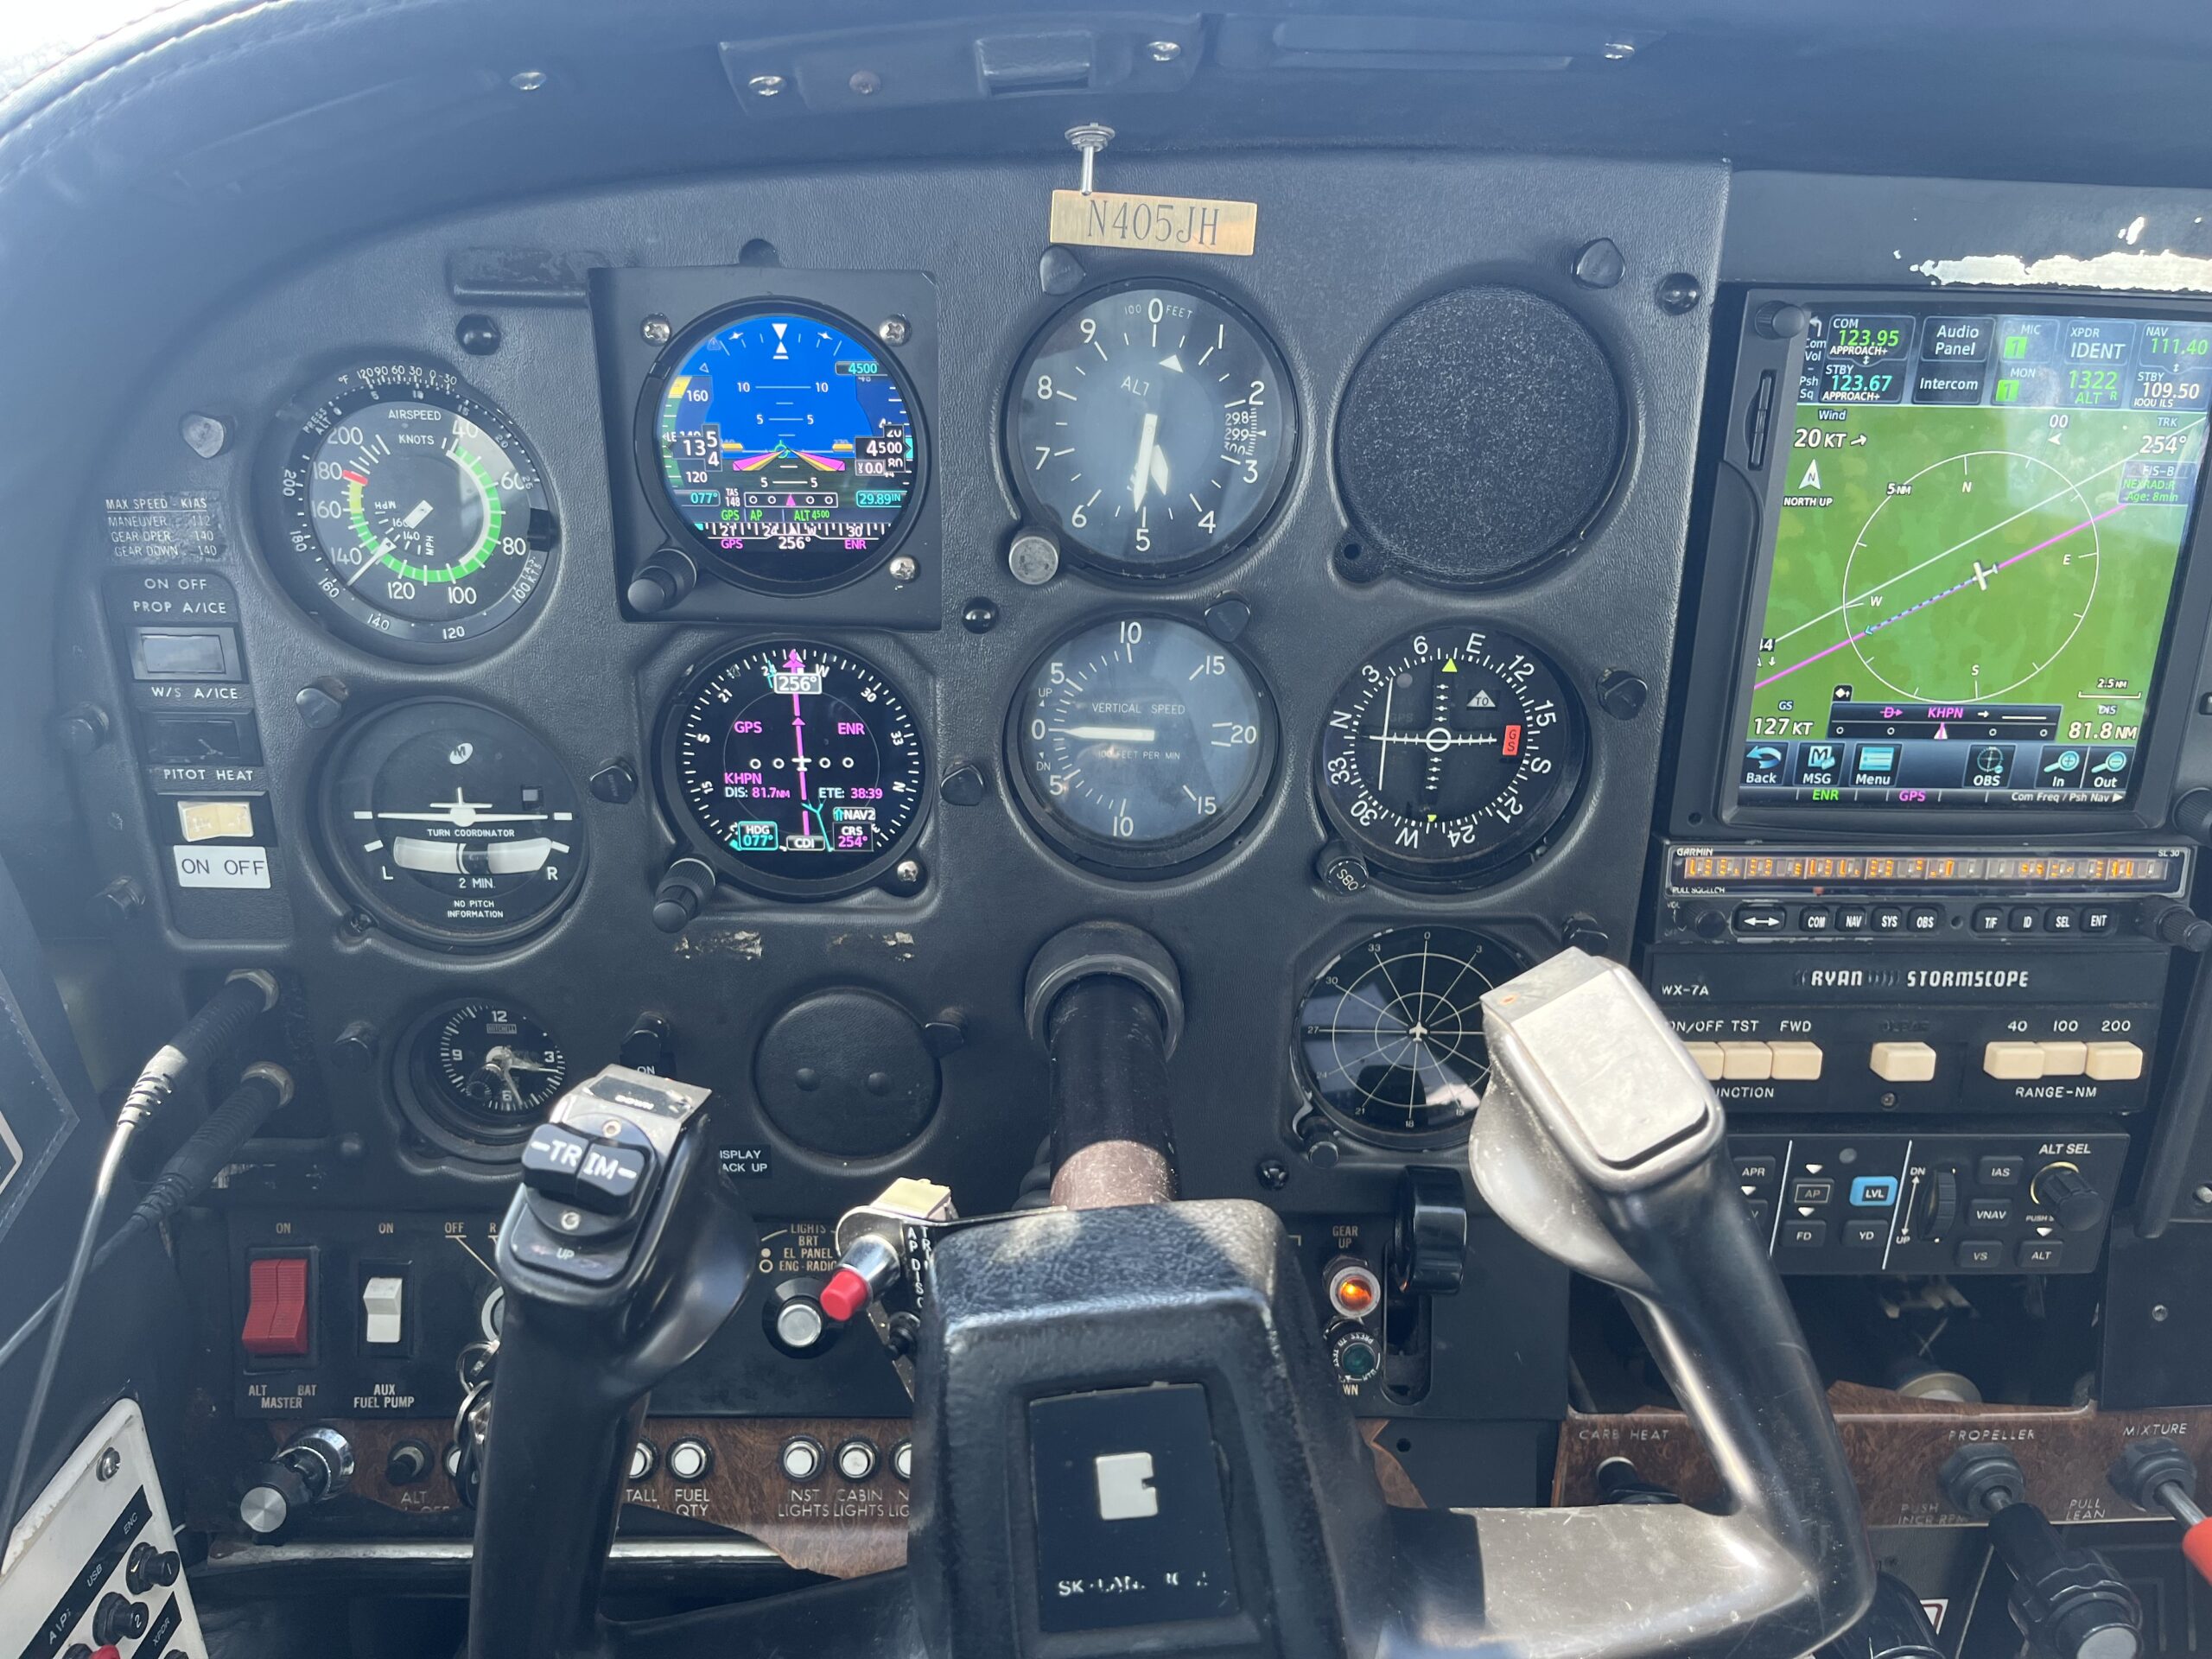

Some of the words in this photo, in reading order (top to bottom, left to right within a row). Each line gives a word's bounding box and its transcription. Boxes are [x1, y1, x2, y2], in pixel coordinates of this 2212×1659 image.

[1087, 199, 1220, 246] N405JH
[1833, 318, 1859, 328] COM
[1936, 324, 1980, 339] Audio
[2020, 324, 2041, 335] MIC
[2070, 327, 2101, 338] XPDR
[2146, 326, 2169, 337] NAV
[1839, 329, 1900, 346] 123.95
[1829, 346, 1888, 357] APPROACH+
[1935, 342, 1976, 356] Panel
[2070, 341, 2126, 359] IDENT
[2151, 337, 2209, 355] 111.40
[1805, 351, 1821, 361] Vol
[848, 362, 878, 374] 4500
[1825, 364, 1854, 375] STBY
[2010, 367, 2036, 378] MON
[1799, 376, 1819, 386] Psh
[1831, 374, 1893, 392] 123.67
[2069, 370, 2119, 390] 1322
[2137, 372, 2164, 382] STBY
[737, 382, 750, 392] 10
[815, 382, 829, 393] 10
[1919, 377, 1980, 391] Intercom
[686, 390, 709, 402] 160
[1821, 391, 1881, 401] APPROACH+
[2143, 382, 2200, 399] 109.50
[388, 409, 442, 421] AIRSPEED
[1818, 410, 1847, 421] Wind
[2157, 416, 2178, 427] TRK
[452, 420, 479, 438] 40
[398, 434, 435, 445] KNOTS
[1793, 428, 1821, 448] 20
[1823, 434, 1847, 448] KT
[313, 461, 342, 480] 180
[685, 471, 709, 483] 120
[105, 499, 129, 510] MAX
[134, 498, 168, 510] SPEED
[181, 498, 207, 509] KIAS
[1783, 497, 1816, 507] NORTH
[1818, 497, 1833, 507] UP
[311, 500, 341, 518] 160
[721, 509, 741, 521] GPS
[749, 509, 763, 520] AP
[503, 537, 526, 556] 80
[721, 538, 744, 550] GPS
[778, 536, 812, 549] 256°
[844, 538, 867, 550] ENR
[331, 547, 362, 565] 140
[144, 578, 169, 589] ON
[178, 579, 207, 590] OFF
[387, 581, 416, 600] 120
[448, 586, 477, 605] 100
[133, 601, 172, 613] PROP
[182, 602, 226, 613] A/ICE
[442, 626, 466, 640] 120
[1120, 620, 1141, 644] 10
[1205, 655, 1225, 675] 15
[1508, 654, 1535, 683] 12
[779, 676, 817, 691] 256°
[151, 686, 182, 698] W/S
[194, 688, 238, 699] A/ICE
[1039, 687, 1052, 697] UP
[1091, 702, 1141, 714] VERTICAL
[1151, 703, 1185, 715] SPEED
[1534, 699, 1557, 728] 15
[1928, 708, 1963, 719] KHPN
[734, 721, 763, 734] GPS
[837, 722, 866, 735] ENR
[1754, 717, 1790, 735] 127
[1792, 721, 1814, 735] KT
[1230, 725, 1257, 744] 20
[1036, 761, 1051, 772] DN
[1327, 757, 1351, 785] 33
[163, 768, 206, 780] PITOT
[217, 769, 253, 781] HEAT
[723, 772, 762, 785] KHPN
[1746, 772, 1777, 784] Back
[1802, 773, 1832, 785] MSG
[1855, 774, 1891, 785] Menu
[1973, 775, 2001, 786] OBS
[2094, 777, 2118, 788] Out
[817, 787, 845, 799] ETE:
[850, 787, 883, 799] 38:39
[1812, 790, 1840, 801] ENR
[1898, 790, 1927, 802] GPS
[1197, 796, 1217, 816] 15
[843, 809, 875, 821] NAV2
[427, 828, 450, 837] TURN
[454, 828, 515, 837] COORDINATOR
[746, 824, 770, 836] HDG
[841, 825, 863, 836] CRS
[1113, 816, 1134, 837] 10
[793, 837, 815, 849] CDI
[837, 835, 868, 848] 254°
[1676, 848, 1713, 856] GARMIN
[181, 858, 210, 875] ON
[224, 859, 265, 875] OFF
[454, 899, 466, 908] NO
[469, 899, 495, 908] PITCH
[447, 910, 504, 918] INFORMATION
[1808, 916, 1826, 928] COM
[1845, 915, 1862, 927] NAV
[1880, 915, 1898, 928] SYS
[1916, 916, 1935, 928] OBS
[2055, 917, 2070, 928] SEL
[2090, 914, 2107, 927] ENT
[1810, 970, 1863, 987] RYAN
[1906, 969, 2029, 988] STORMSCOPE
[1662, 984, 1709, 996] WX-7A
[492, 1010, 508, 1023] 12
[2007, 1020, 2028, 1033] 40
[2053, 1020, 2079, 1033] 100
[2101, 1020, 2132, 1033] 200
[2038, 1143, 2064, 1154] ALT
[2066, 1143, 2092, 1154] SEL
[1741, 1167, 1765, 1177] APR
[1910, 1166, 1926, 1176] DN
[1991, 1167, 2011, 1178] IAS
[1865, 1189, 1885, 1198] LVL
[1976, 1210, 2006, 1220] VNAV
[276, 1223, 291, 1234] ON
[378, 1223, 394, 1234] ON
[444, 1222, 465, 1234] OFF
[1332, 1225, 1359, 1237] GEAR
[798, 1235, 819, 1247] BRT
[1796, 1231, 1812, 1241] FD
[1859, 1231, 1875, 1241] YD
[1895, 1236, 1910, 1245] UP
[1338, 1237, 1352, 1249] UP
[783, 1248, 796, 1260] EL
[801, 1248, 834, 1260] PANEL
[1974, 1251, 1989, 1261] VS
[2031, 1250, 2052, 1261] ALT
[248, 1384, 267, 1396] ALT
[297, 1384, 317, 1396] BAT
[373, 1383, 396, 1396] AUX
[261, 1396, 302, 1409] MASTER
[353, 1396, 380, 1409] FUEL
[384, 1396, 416, 1408] PUMP
[1578, 1428, 1624, 1441] CARB
[1630, 1427, 1669, 1441] HEAT
[1947, 1428, 2036, 1441] PROPELLER
[2122, 1423, 2189, 1437] MIXTURE
[401, 1491, 428, 1504] ALT
[674, 1489, 710, 1502] FUEL
[836, 1488, 883, 1502] CABIN
[2068, 1497, 2101, 1510] PULL
[778, 1503, 829, 1517] LIGHTS
[833, 1503, 884, 1517] LIGHTS
[2065, 1509, 2106, 1521] LEAN
[86, 1563, 104, 1588] USB
